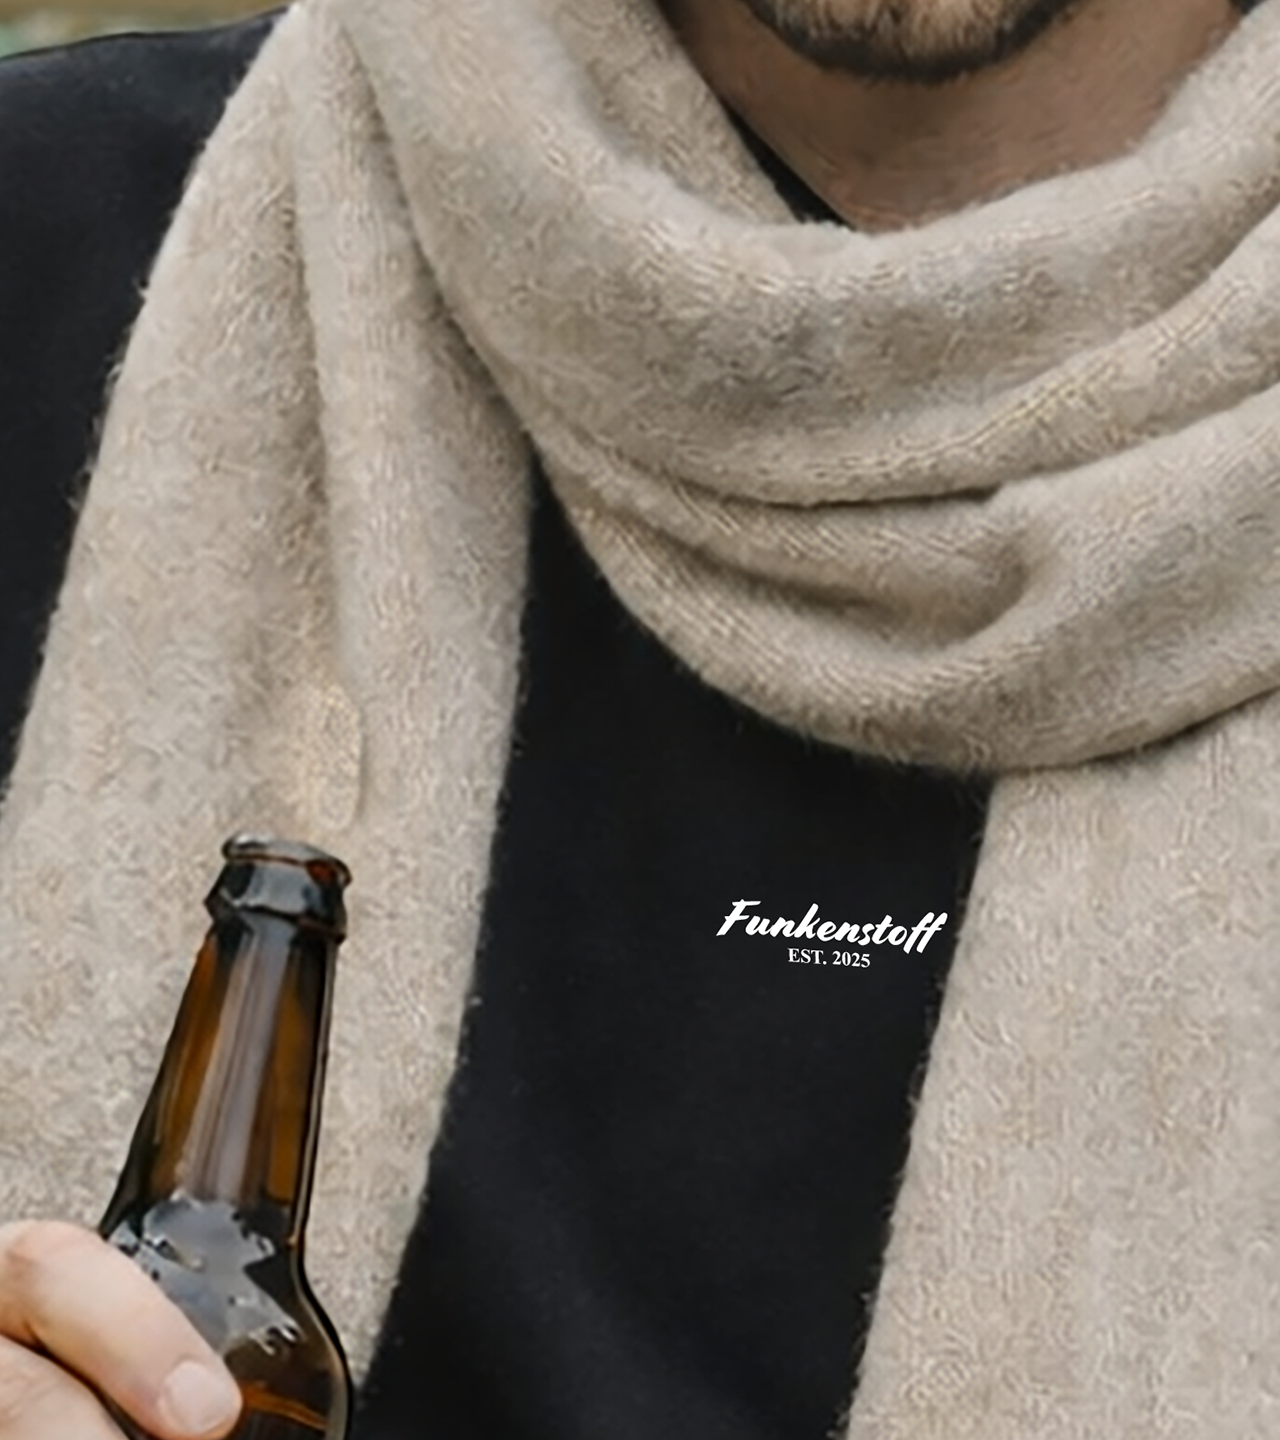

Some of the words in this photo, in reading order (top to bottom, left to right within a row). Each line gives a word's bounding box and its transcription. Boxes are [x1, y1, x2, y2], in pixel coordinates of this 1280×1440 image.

[716, 898, 949, 955] Funkenstoff
[787, 947, 828, 966] EST.
[831, 949, 871, 969] 2025
